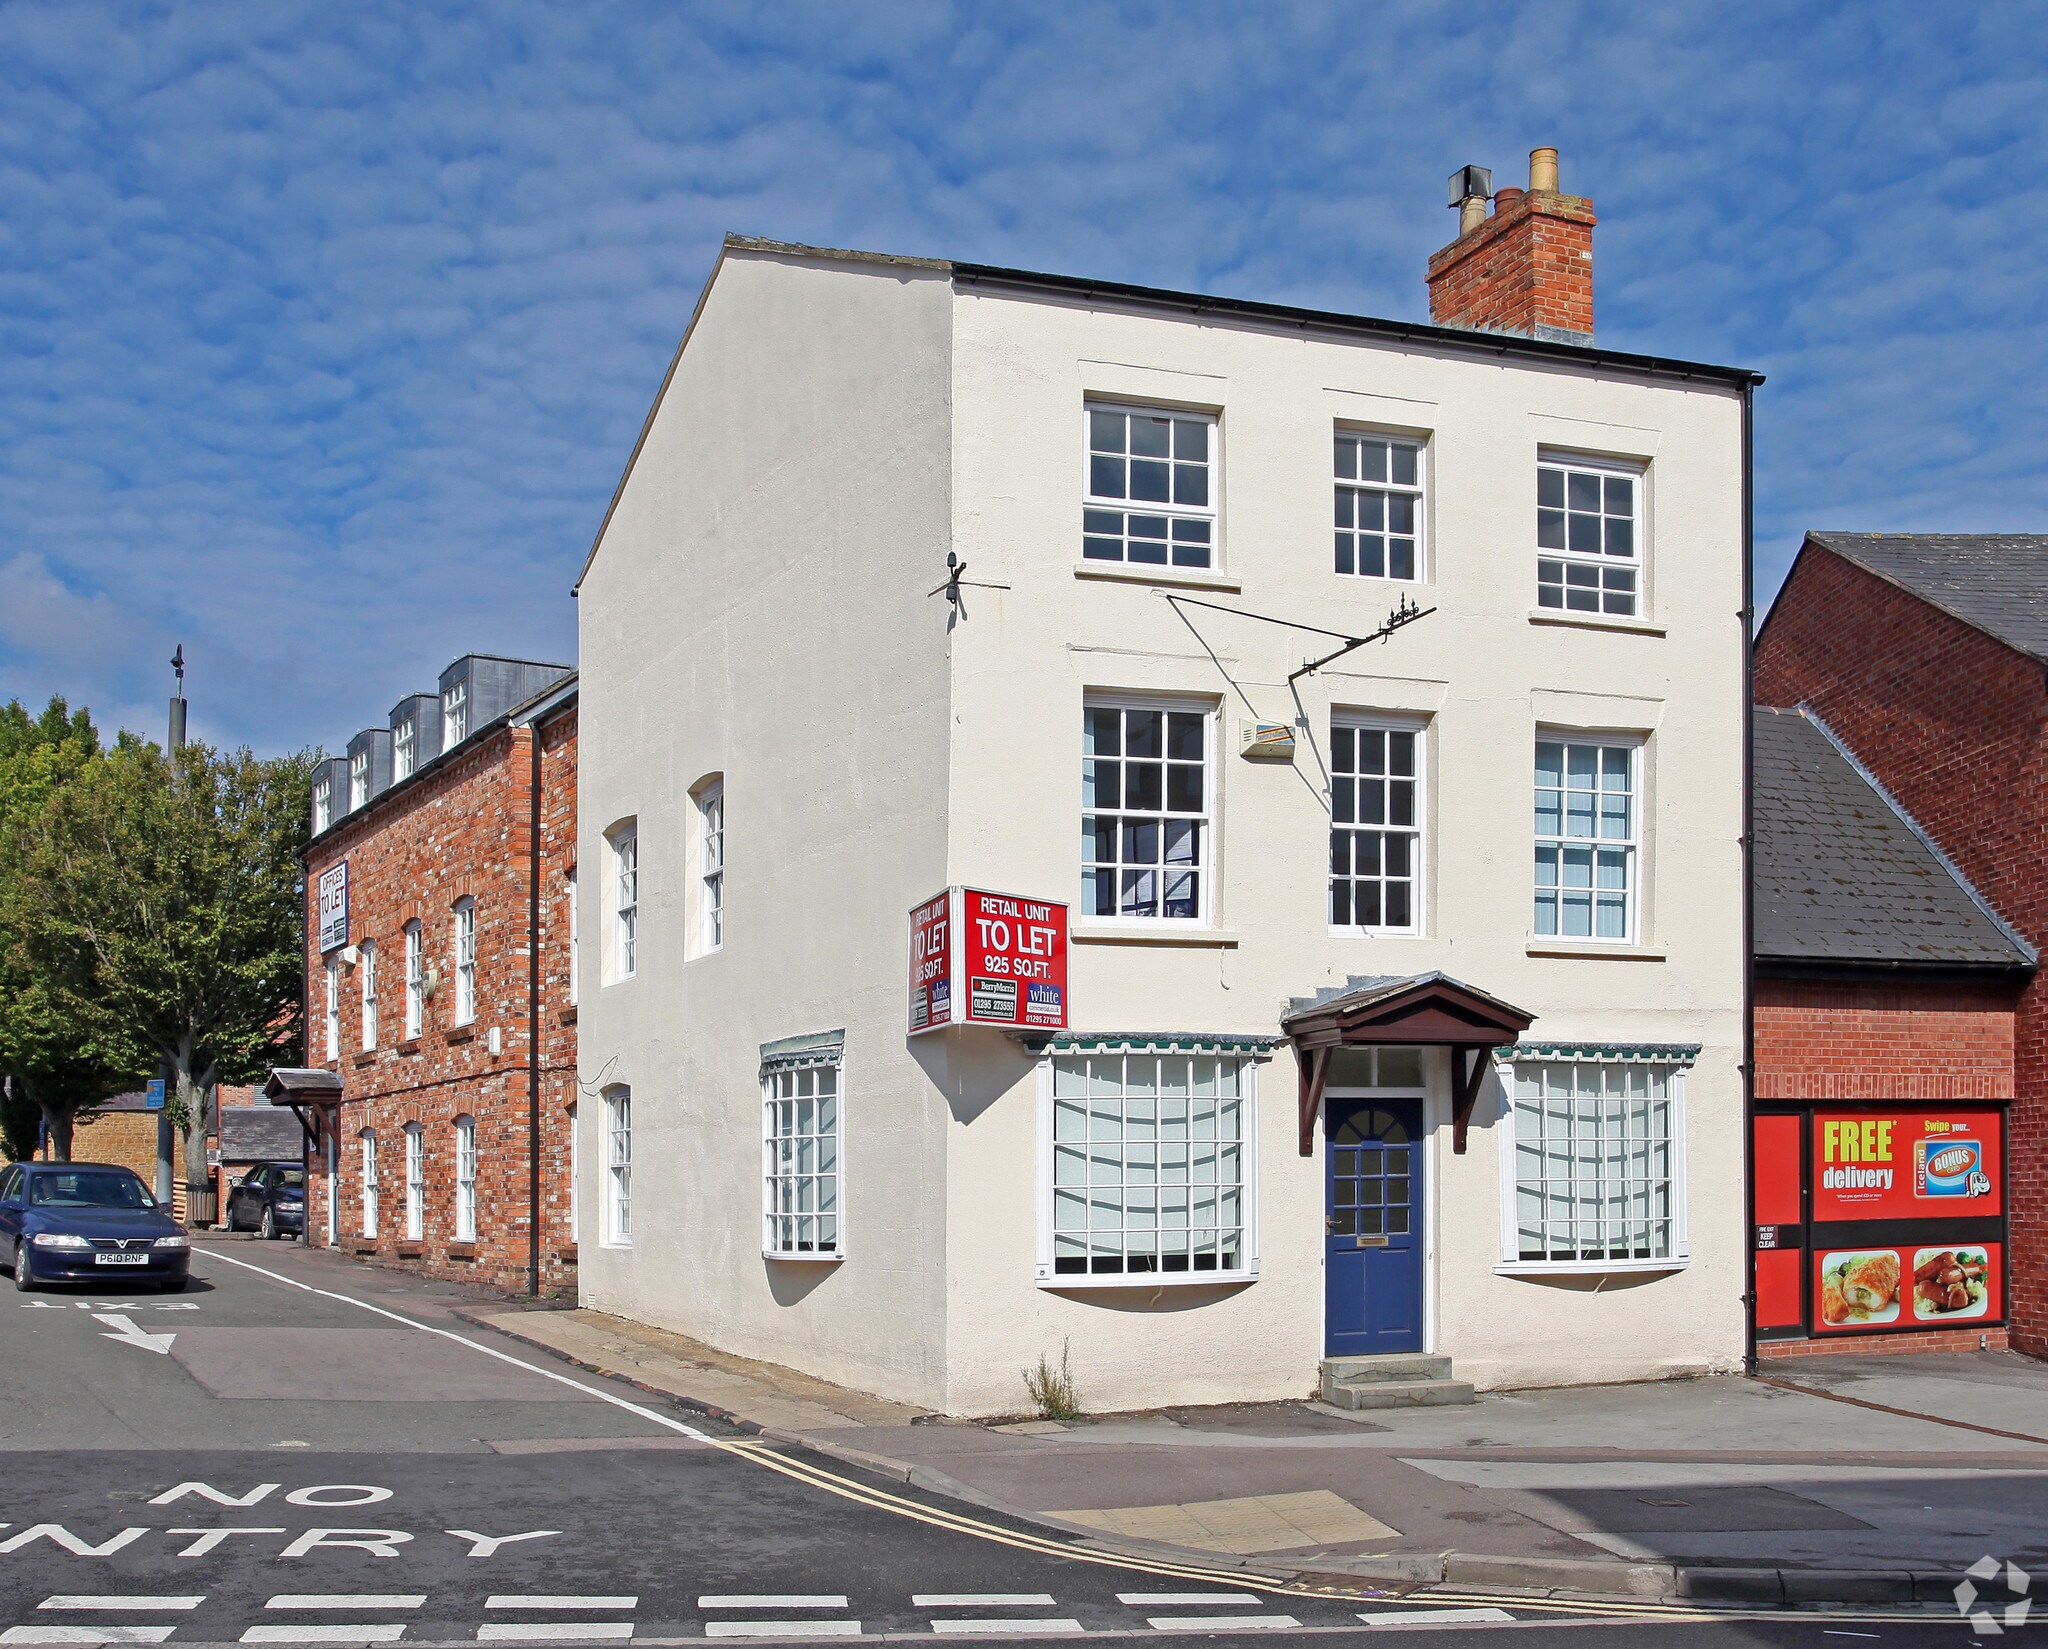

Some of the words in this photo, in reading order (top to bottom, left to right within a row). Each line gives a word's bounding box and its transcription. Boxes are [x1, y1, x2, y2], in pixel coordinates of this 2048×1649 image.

[322, 868, 343, 891] OFFICES
[321, 894, 330, 916] TO
[331, 886, 345, 910] LET
[932, 899, 945, 919] UNIT
[981, 897, 1022, 918] RETAIL
[1025, 903, 1051, 922] UNIT
[914, 930, 925, 960] TO
[927, 920, 947, 956] LET
[976, 918, 1010, 952] TO
[1017, 924, 1056, 957] LET
[984, 955, 1009, 974] 925
[1013, 958, 1051, 979] SQ.FT.
[1030, 985, 1059, 1004] white
[1026, 1015, 1043, 1024] 01295
[1043, 1016, 1062, 1025] 271000
[1924, 1120, 1950, 1132] Swipe
[1917, 1149, 1926, 1189] Iceland
[1934, 1150, 1969, 1172] BONUS
[1823, 1166, 1894, 1190] delivery
[1758, 1240, 1776, 1248] CLEAR
[1760, 1232, 1773, 1240] KEEP
[100, 1254, 123, 1263] P610
[125, 1254, 144, 1263] PNF
[20, 1301, 200, 1310] EXIT
[147, 1482, 393, 1507] NO
[0, 1523, 563, 1558] NTRY
